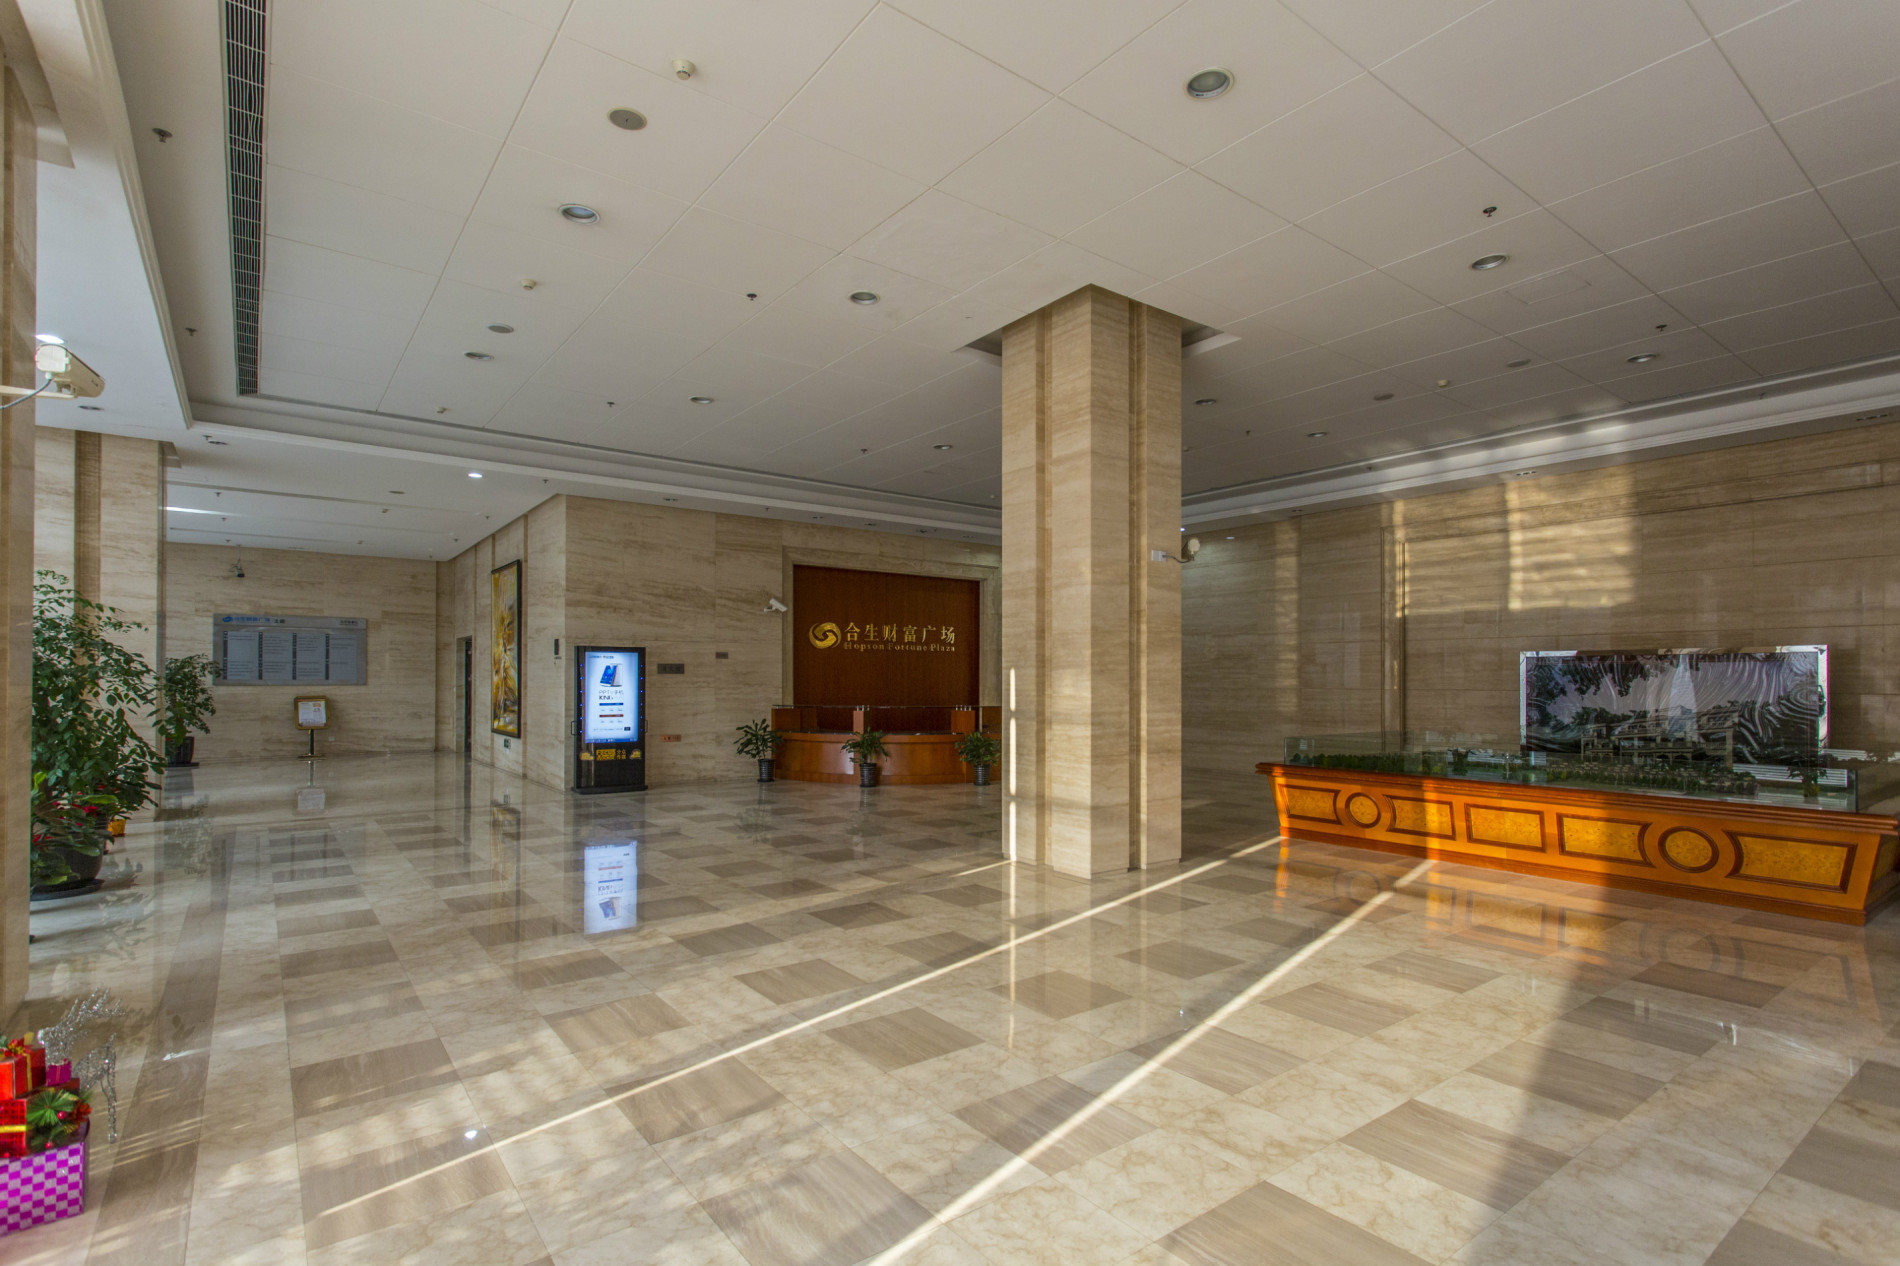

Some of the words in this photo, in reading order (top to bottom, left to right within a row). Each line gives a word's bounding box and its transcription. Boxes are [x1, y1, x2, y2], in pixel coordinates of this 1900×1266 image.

[844, 622, 956, 644] 合生财富广场
[844, 642, 885, 651] Hopson
[888, 642, 928, 651] Fortune
[931, 644, 956, 652] Plaza
